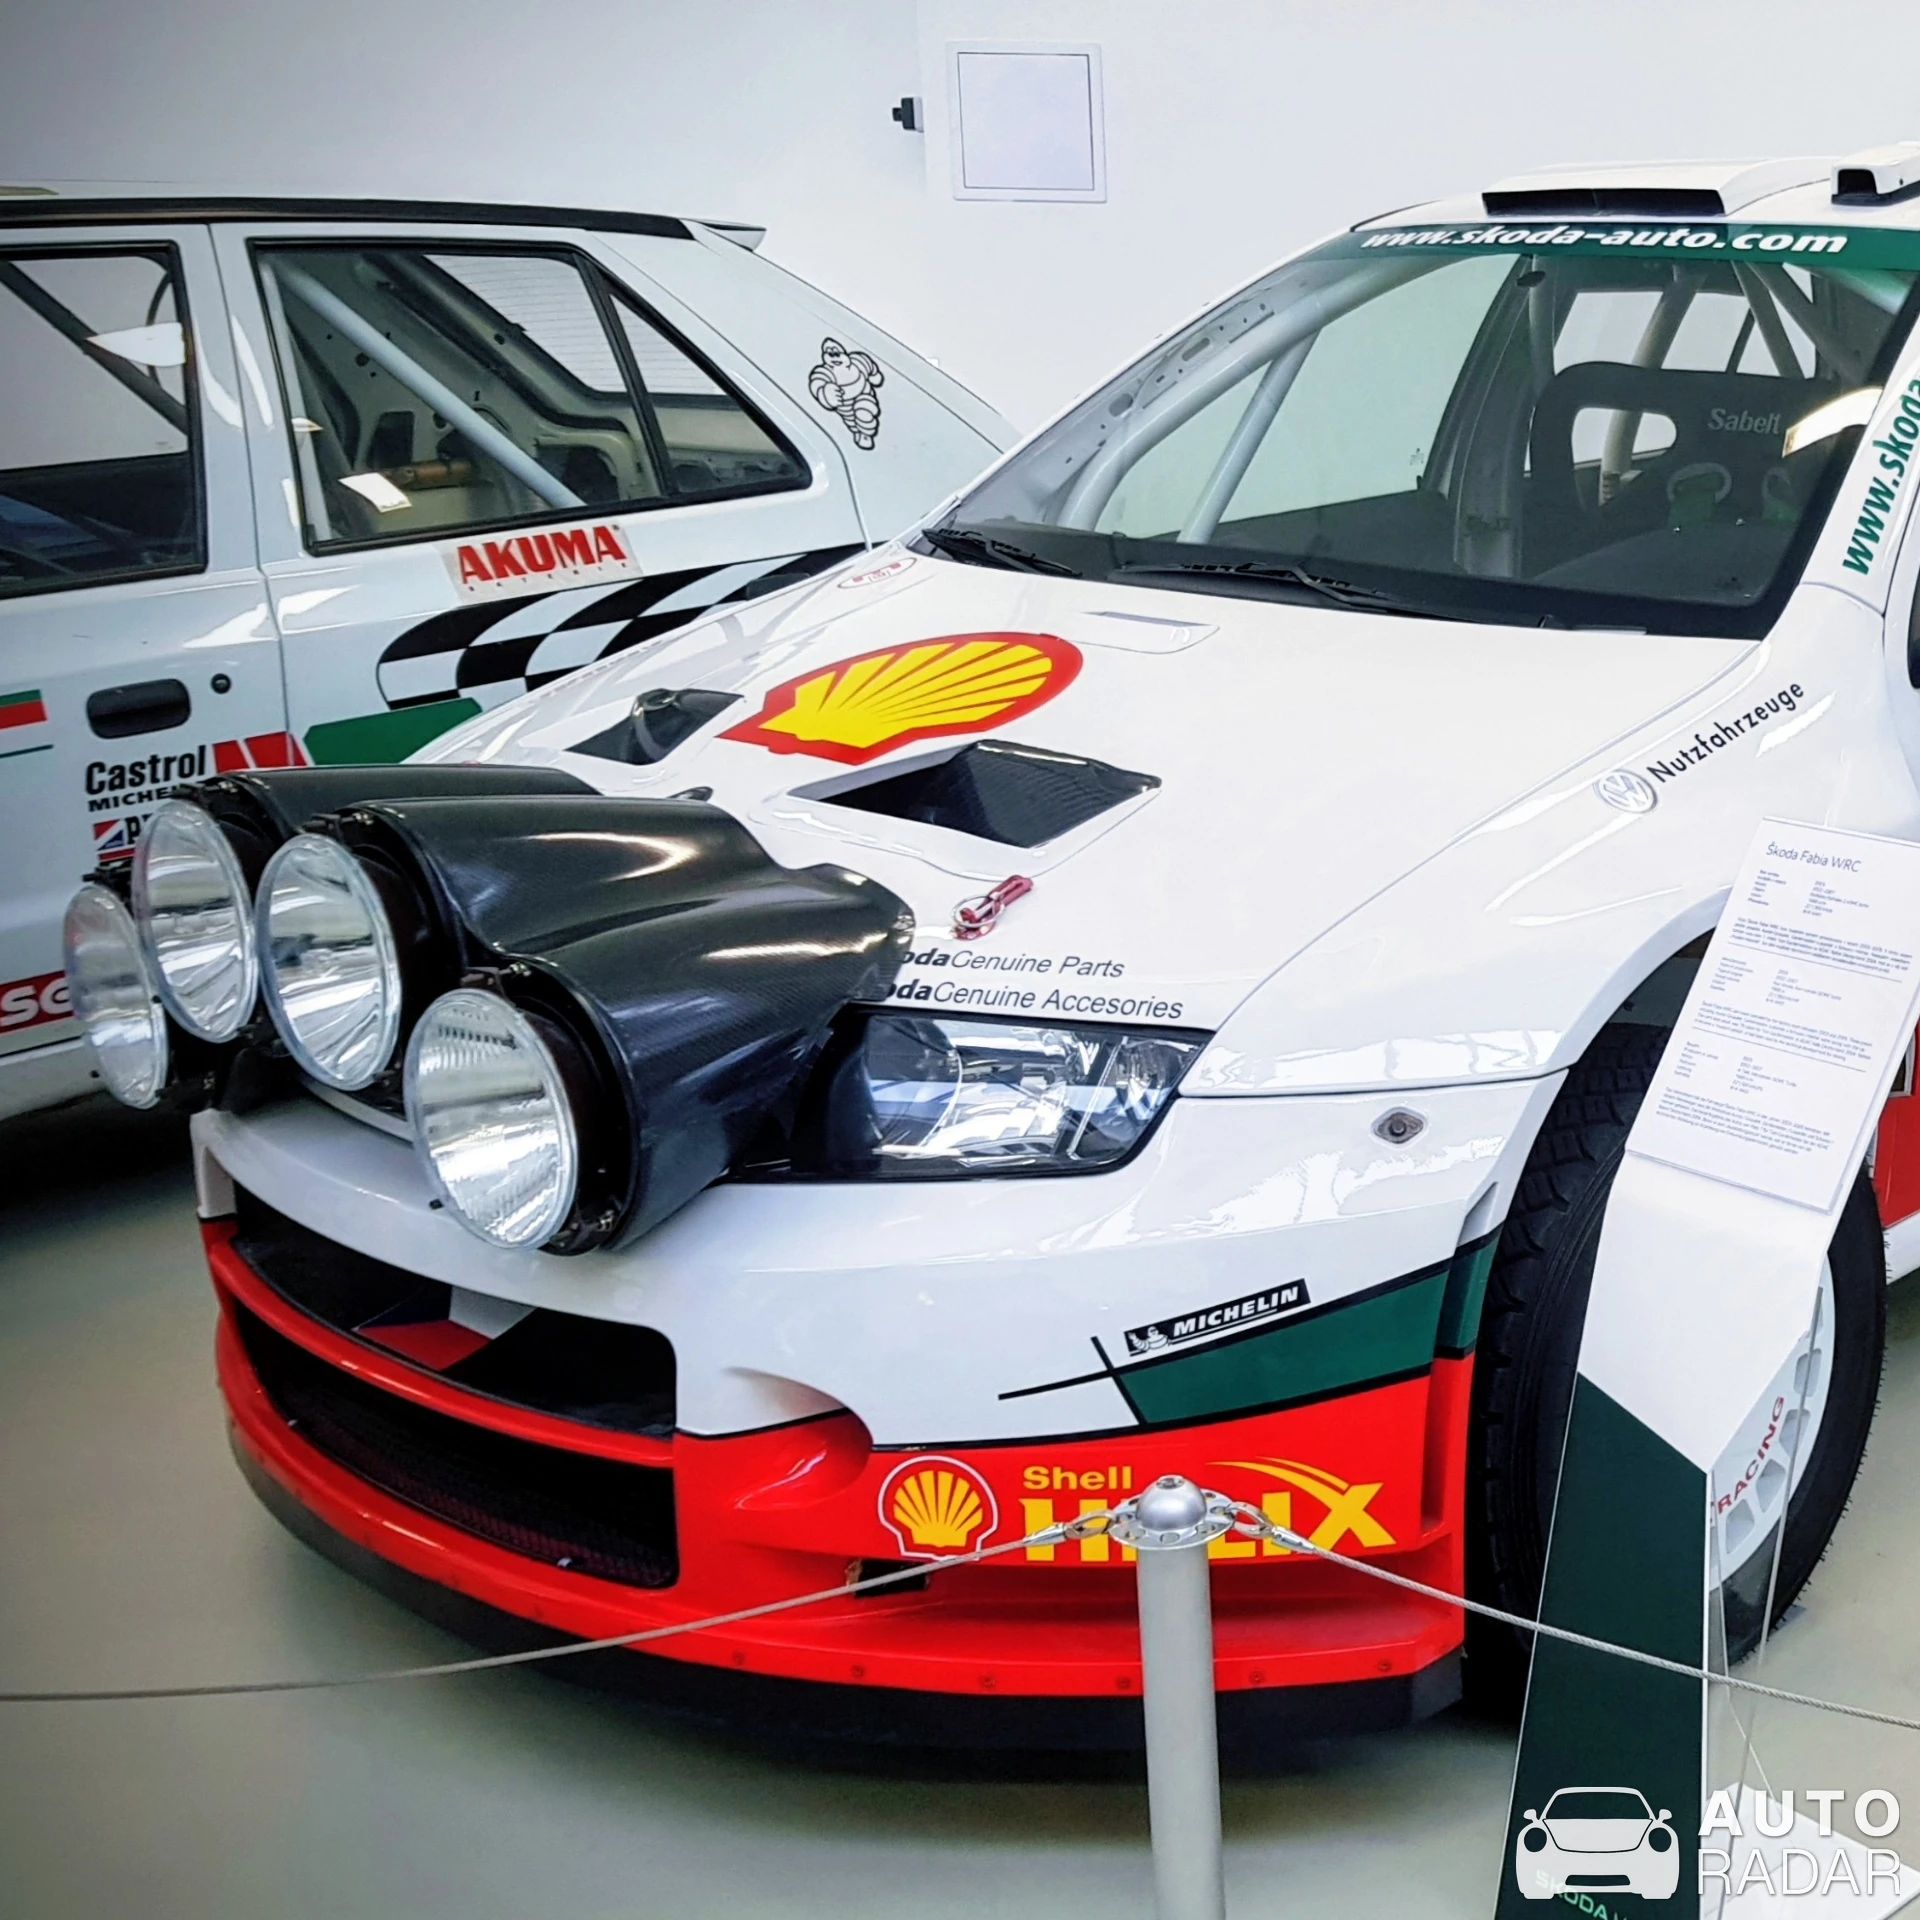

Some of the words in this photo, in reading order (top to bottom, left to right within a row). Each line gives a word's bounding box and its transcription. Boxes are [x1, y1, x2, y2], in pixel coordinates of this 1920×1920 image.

[1360, 224, 1848, 254] www.skoda-auto.com
[1707, 407, 1781, 434] Sabelt
[457, 526, 627, 584] AKUMA
[1646, 683, 1804, 783] Nutzfahrzeuge
[86, 744, 206, 795] Castrol
[88, 785, 178, 812] MICHE
[1766, 841, 1799, 861] Škoda
[1800, 850, 1829, 866] Fabia
[1831, 856, 1862, 873] WRC
[1058, 955, 1126, 978] Parts
[1041, 988, 1184, 1019] Accesories
[1173, 1286, 1299, 1338] MICHELIN
[1717, 1396, 1784, 1515] RACING
[1023, 1466, 1132, 1490] Shell
